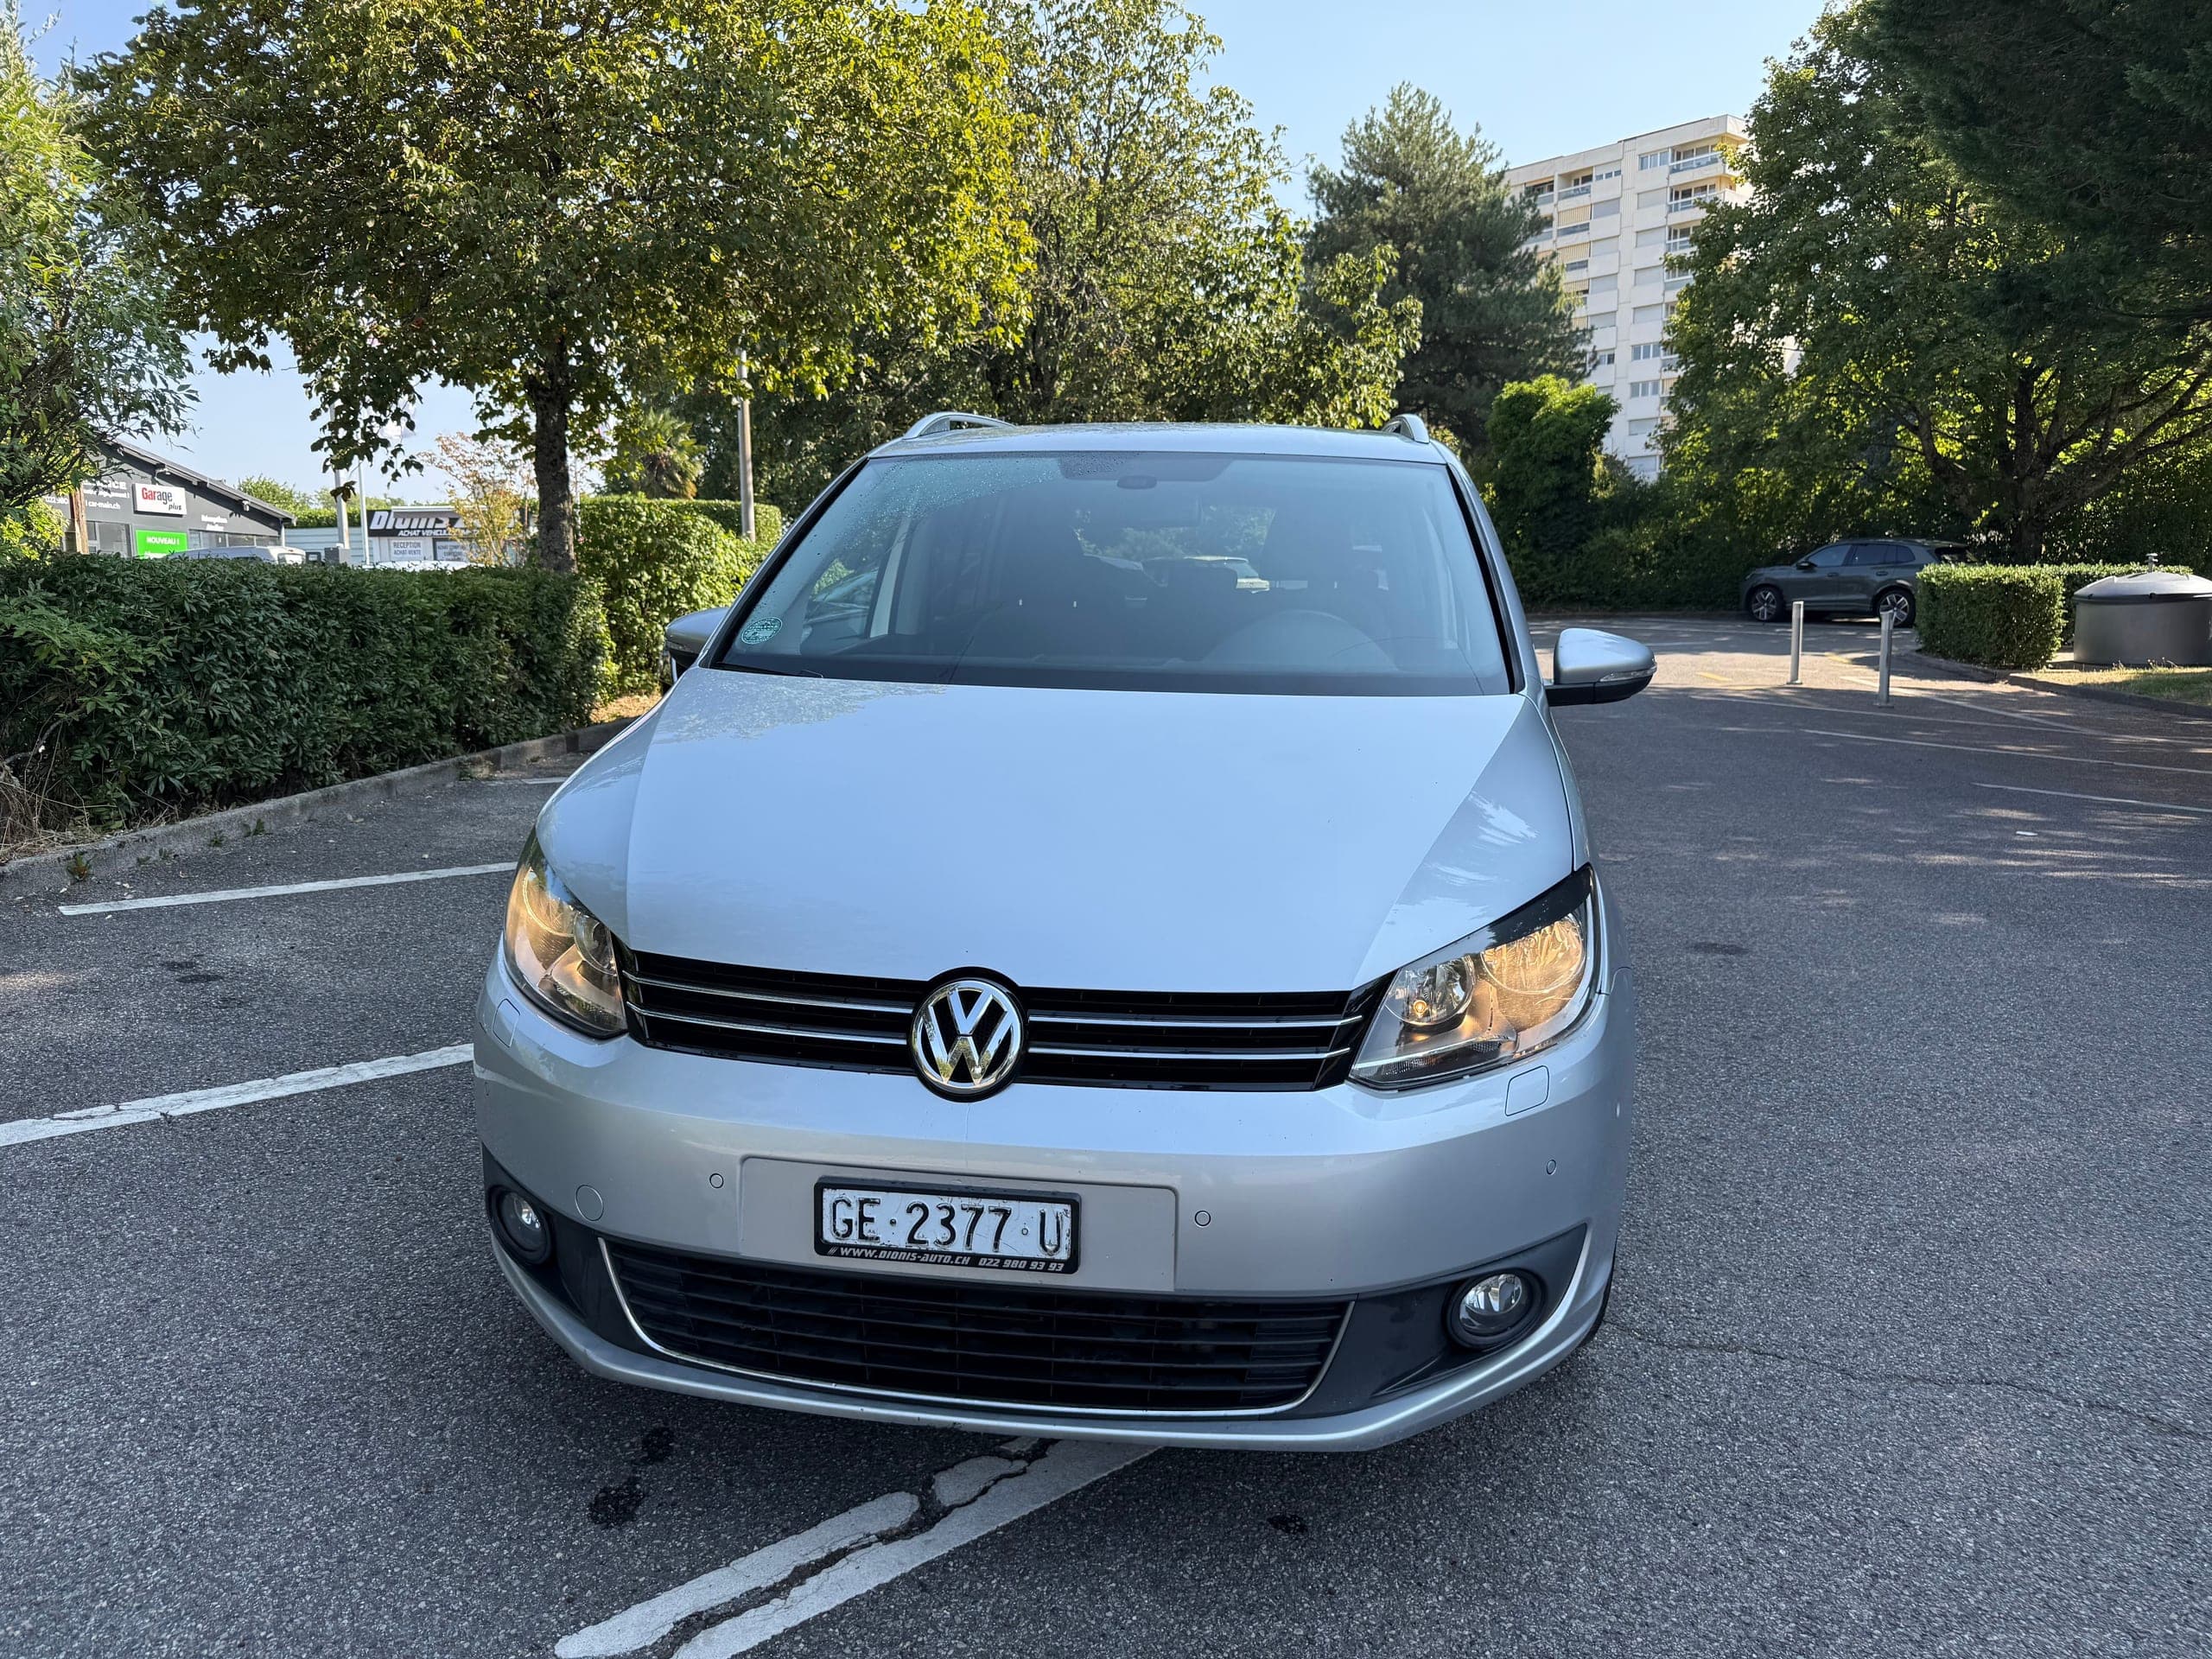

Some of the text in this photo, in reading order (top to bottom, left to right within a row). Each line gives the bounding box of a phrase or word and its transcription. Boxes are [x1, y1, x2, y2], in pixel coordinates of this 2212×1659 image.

[141, 487, 174, 505] Garage
[146, 537, 175, 545] NOUVEAU
[916, 982, 1020, 1087] VW
[831, 1197, 1064, 1256] GE 2377 U
[978, 1256, 1000, 1268] 022
[1002, 1259, 1027, 1269] 980
[1029, 1262, 1046, 1270] 93
[1047, 1262, 1065, 1272] 93
